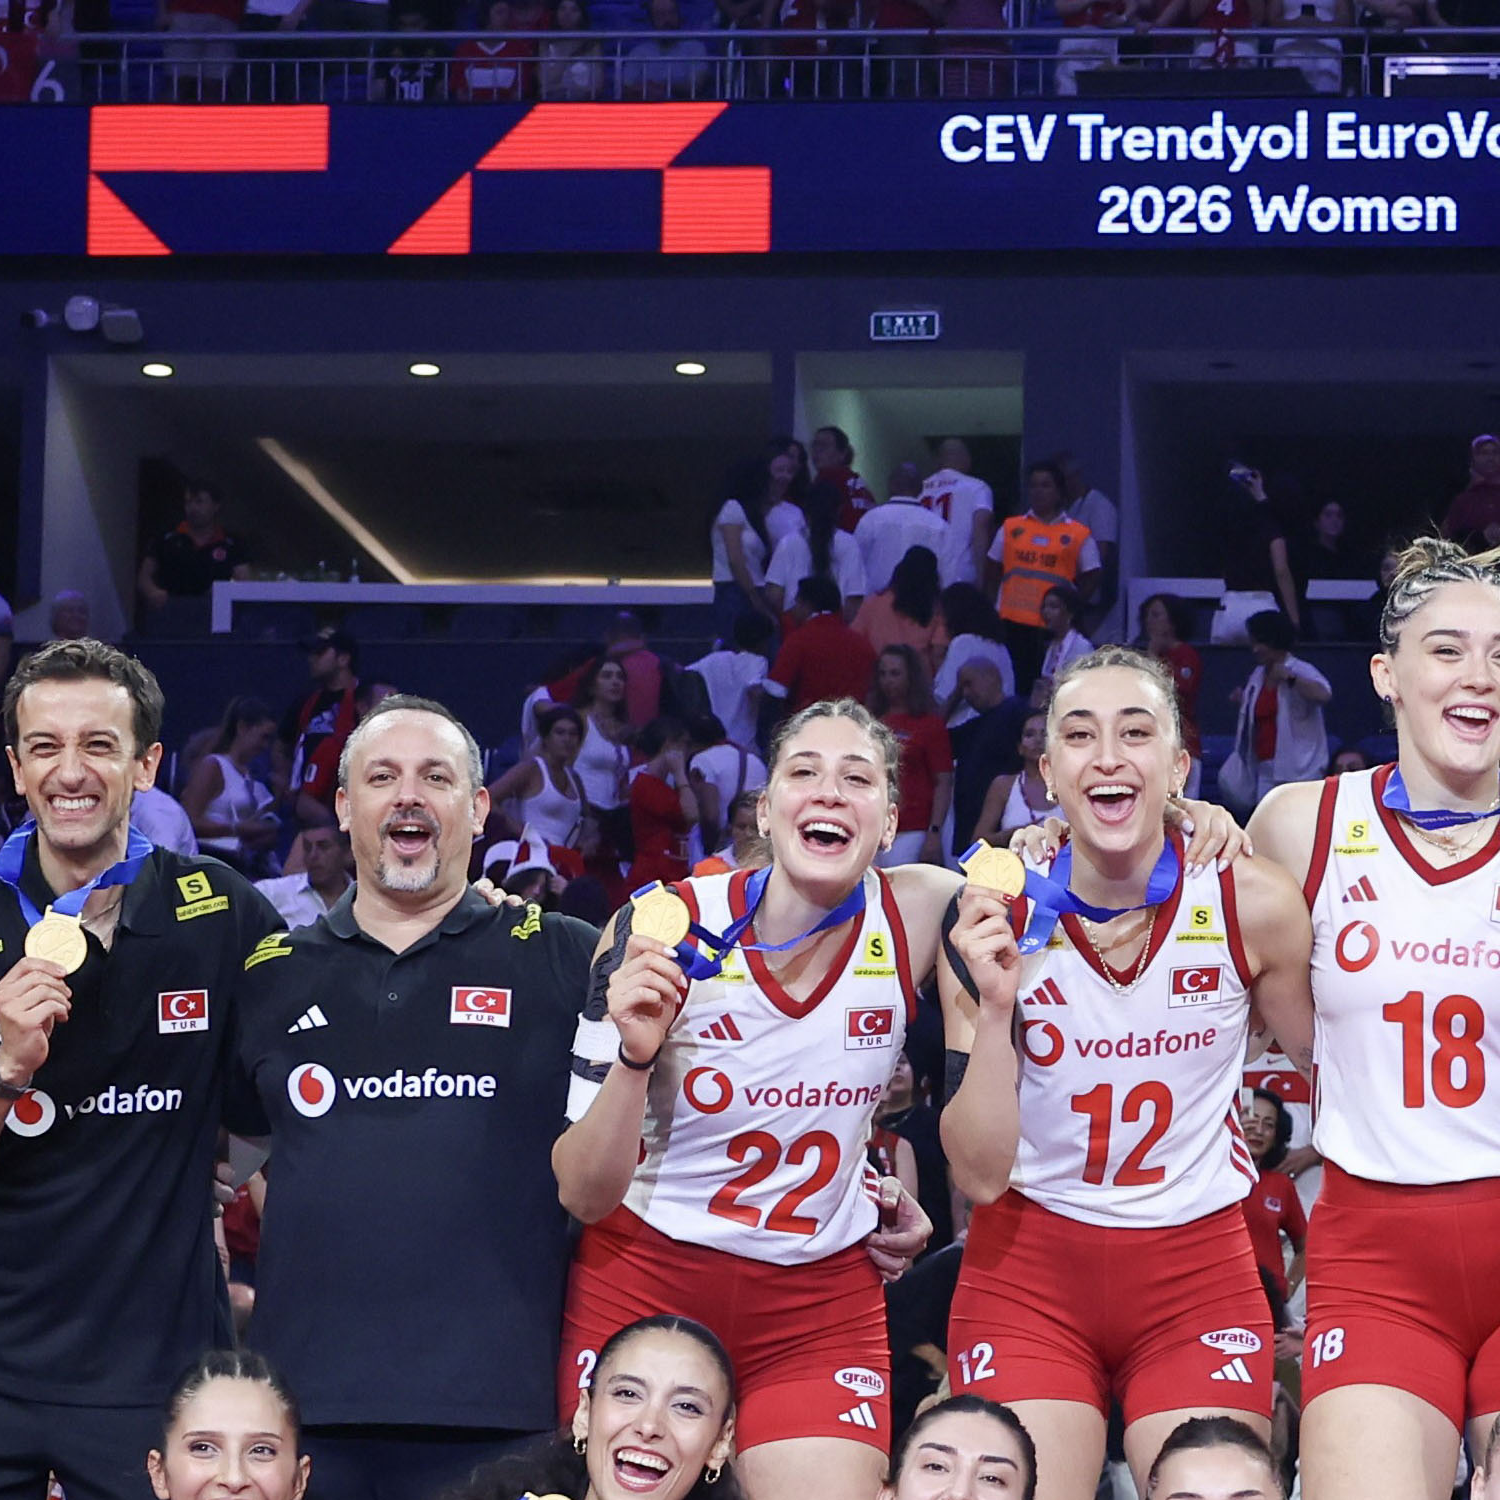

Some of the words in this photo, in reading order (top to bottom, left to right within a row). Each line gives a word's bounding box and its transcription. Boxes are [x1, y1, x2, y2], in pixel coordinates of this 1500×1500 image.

[940, 115, 1056, 166] CEV
[1068, 113, 1309, 171] Trendyol
[1098, 186, 1233, 234] 2026
[1248, 186, 1457, 233] Women
[1351, 822, 1365, 842] S
[186, 878, 205, 897] S
[1193, 906, 1210, 926] S
[869, 936, 885, 961] S
[1181, 994, 1210, 1005] TUR
[172, 1020, 197, 1031] TUR
[468, 1013, 500, 1025] TUR
[857, 1034, 884, 1049] TUR
[1074, 1026, 1218, 1061] vodafone
[1382, 990, 1486, 1110] 18
[343, 1069, 496, 1099] vodafone
[742, 1077, 883, 1107] vodafone
[1070, 1080, 1175, 1188] 12
[706, 1129, 841, 1236] 22
[1208, 1328, 1258, 1347] gratis
[1311, 1328, 1344, 1367] 18
[958, 1342, 996, 1384] 12
[841, 1367, 883, 1388] gratis
